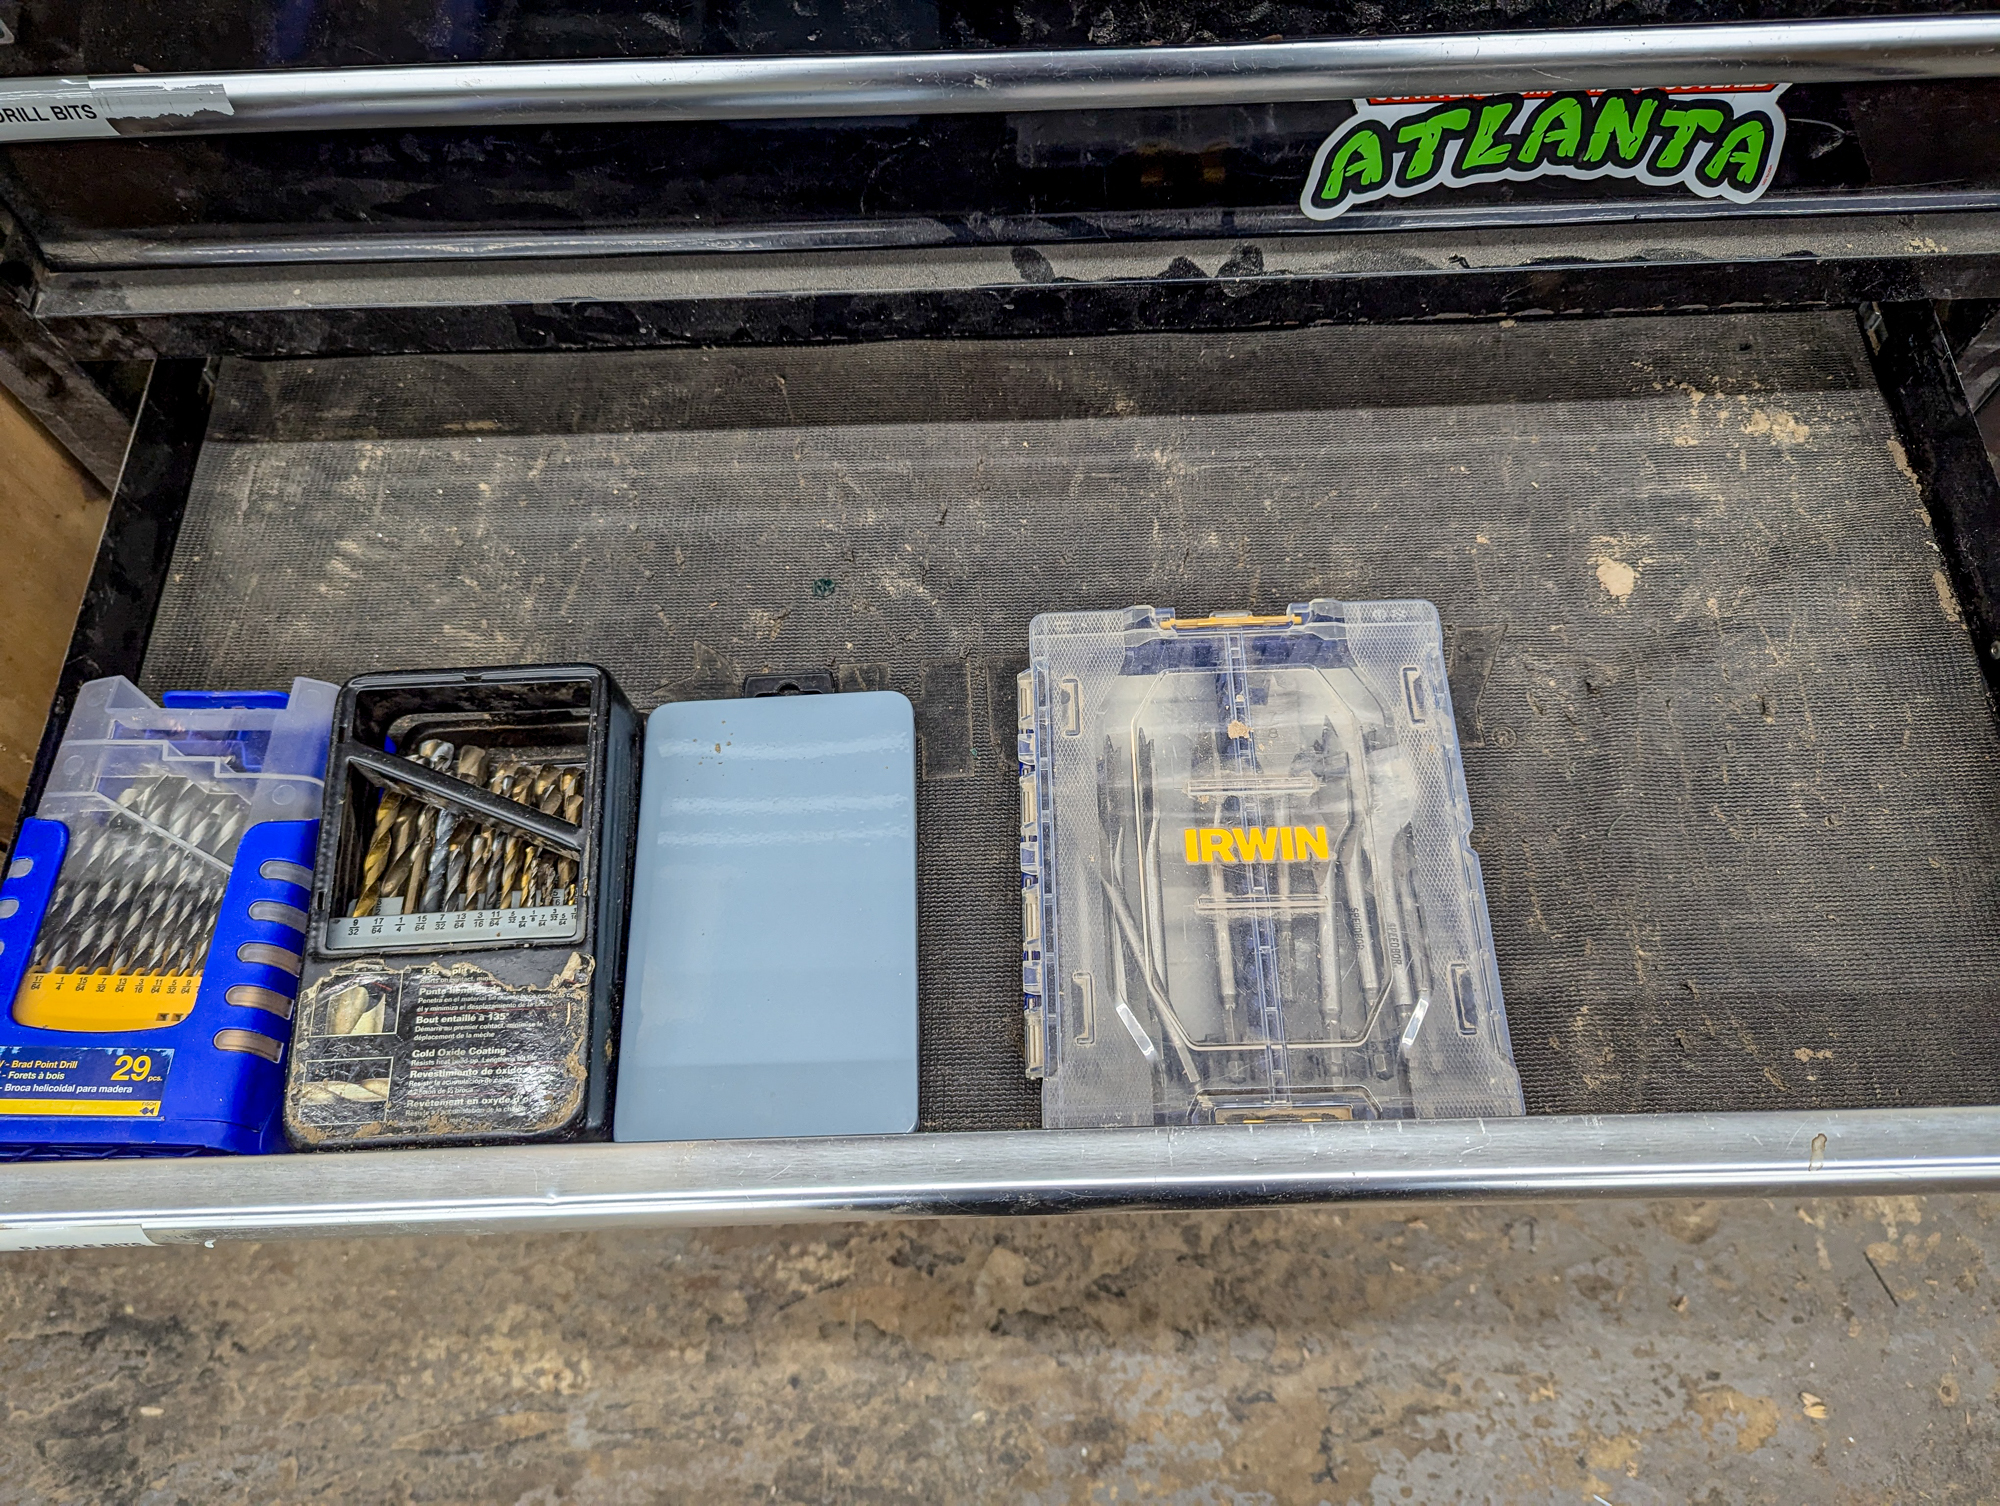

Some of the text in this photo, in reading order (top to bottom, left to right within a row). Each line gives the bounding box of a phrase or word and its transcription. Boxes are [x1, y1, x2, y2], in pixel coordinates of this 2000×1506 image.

[49, 104, 98, 121] BITS
[1318, 96, 1767, 201] ATLANTA
[1184, 825, 1330, 864] IRWIN
[415, 1015, 439, 1025] Bout
[440, 1012, 477, 1023] entaillé
[411, 1046, 507, 1058] Gold Oxide Coating
[11, 1060, 33, 1069] Brad
[34, 1060, 58, 1069] Point
[59, 1060, 78, 1069] Drill
[110, 1055, 163, 1083] 29 pcs.
[8, 1071, 37, 1080] Forets
[38, 1072, 44, 1080] à
[46, 1071, 65, 1080] bois
[409, 1068, 478, 1079] Revestimiento
[481, 1067, 494, 1076] de
[4, 1083, 31, 1092] Broca
[33, 1084, 75, 1093] helicoidal
[76, 1085, 97, 1094] para
[98, 1085, 133, 1094] madera
[481, 1096, 511, 1106] oxyde
